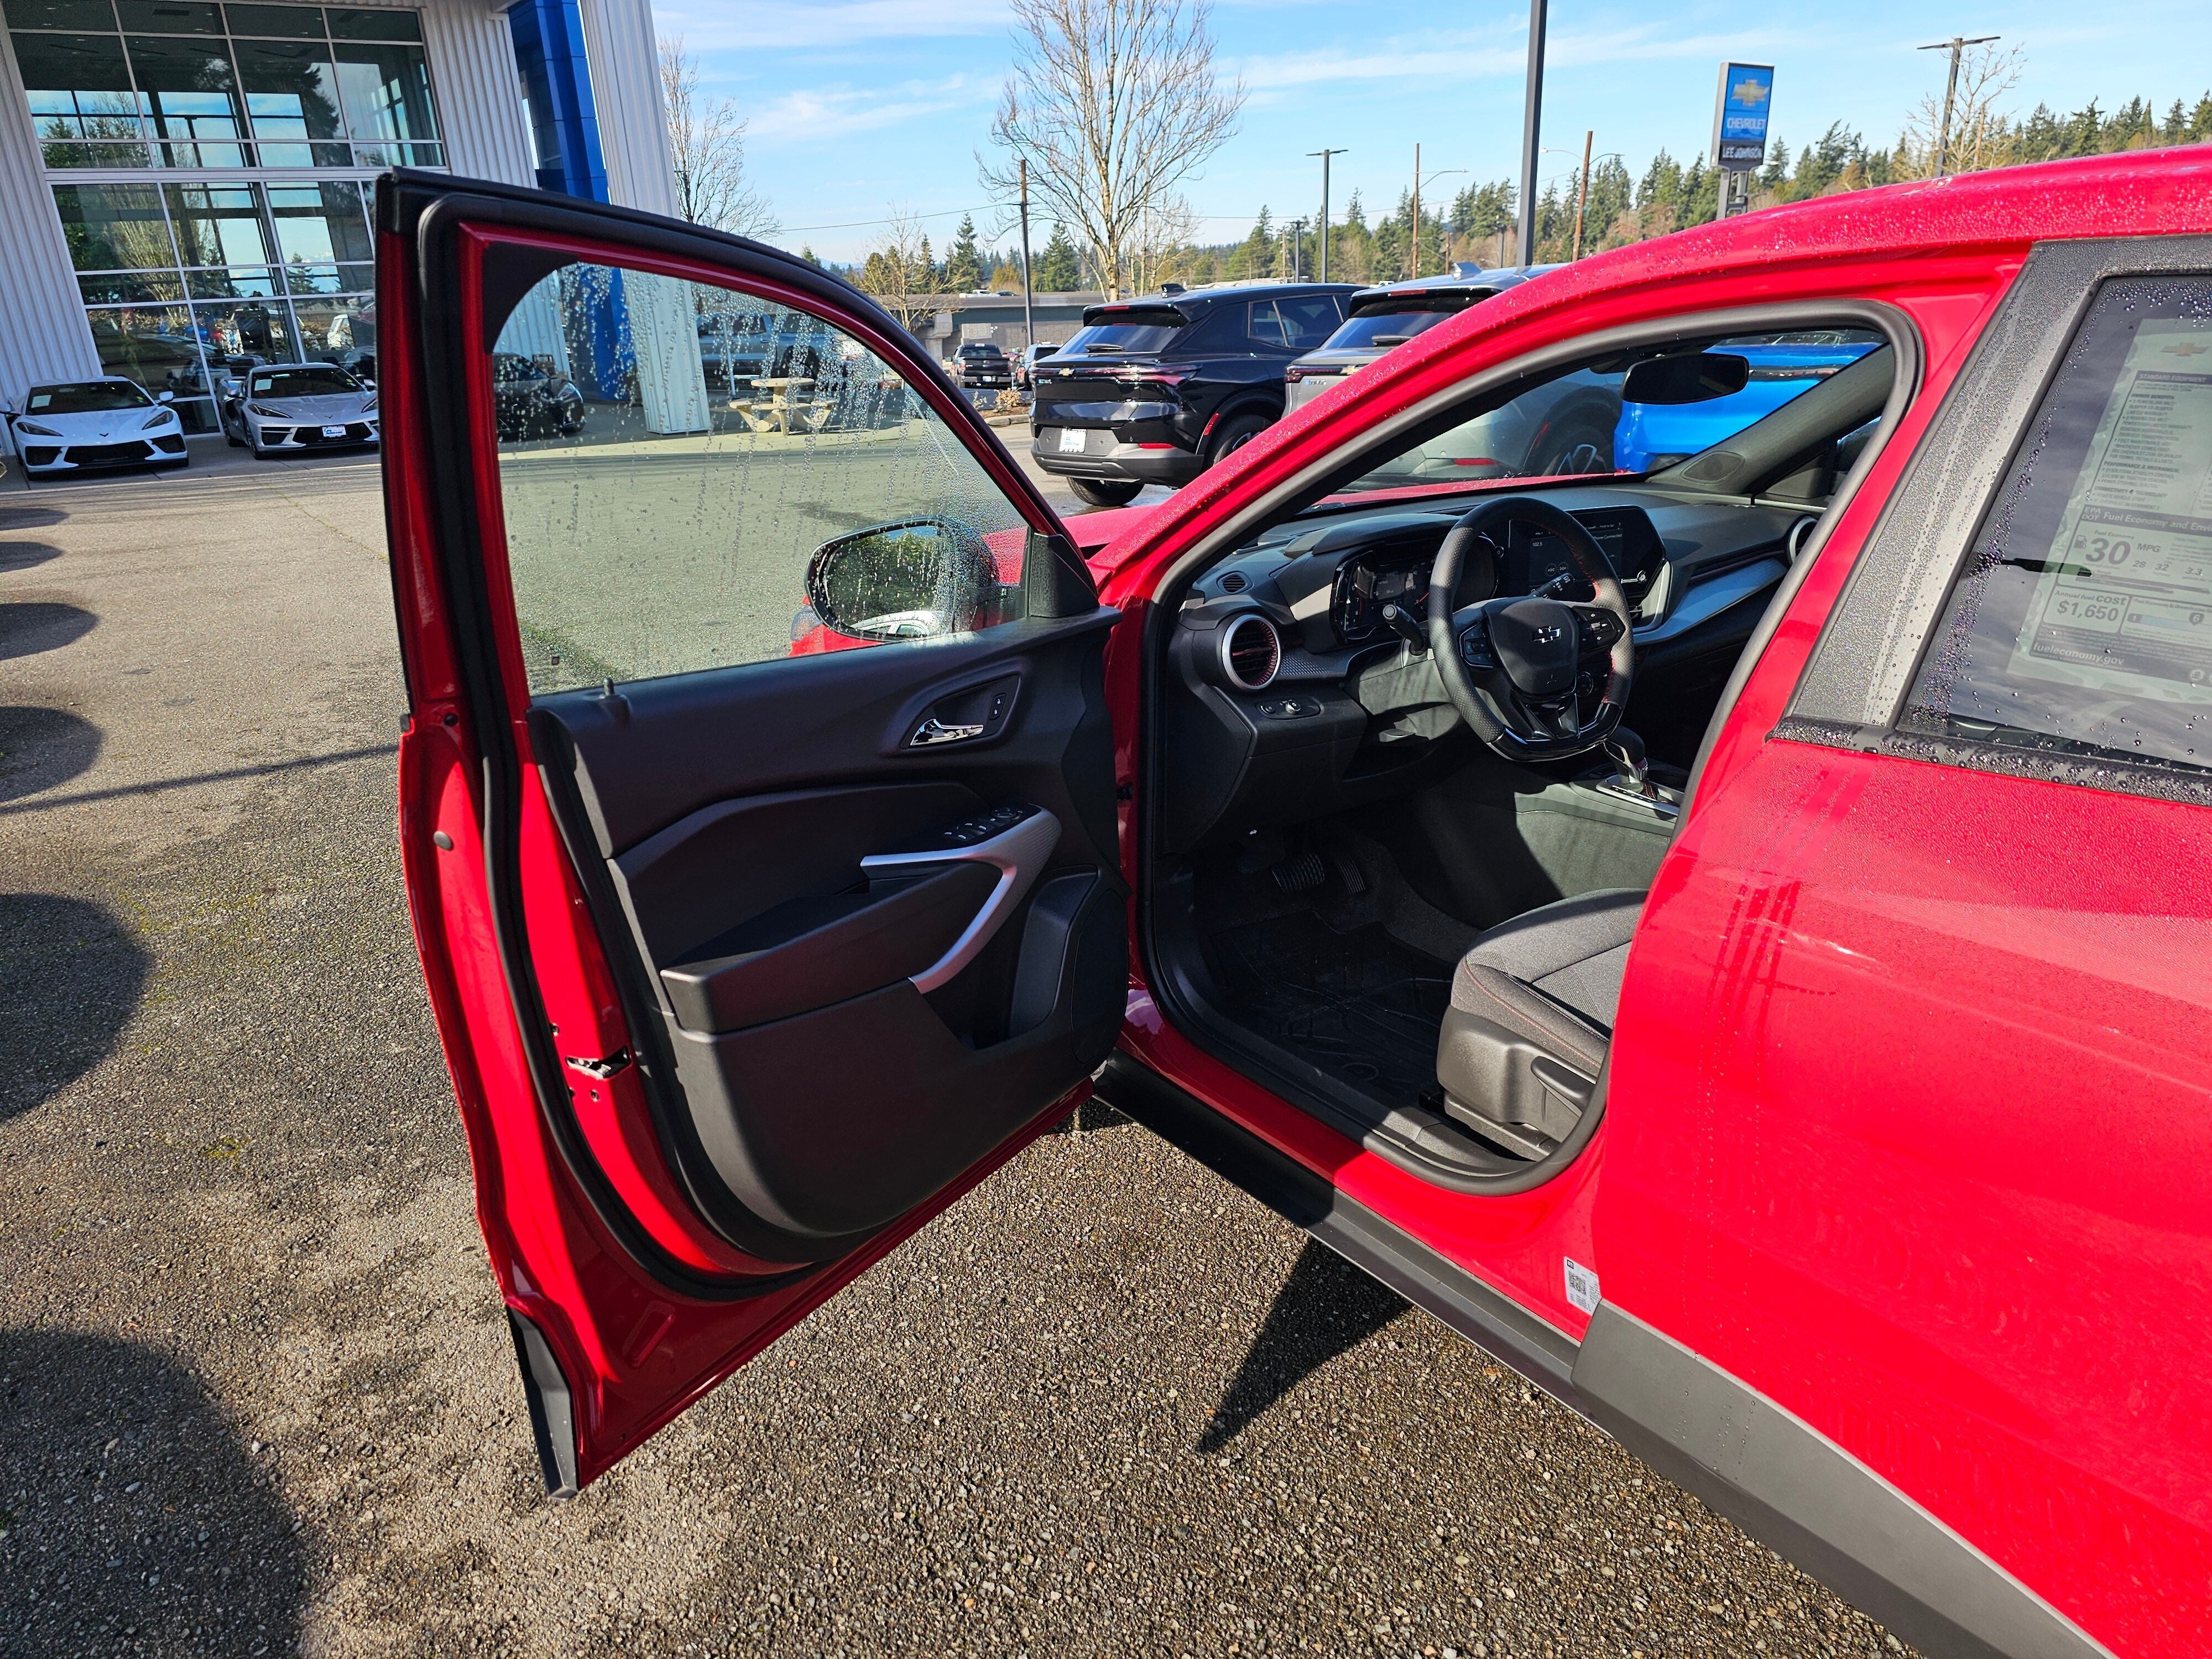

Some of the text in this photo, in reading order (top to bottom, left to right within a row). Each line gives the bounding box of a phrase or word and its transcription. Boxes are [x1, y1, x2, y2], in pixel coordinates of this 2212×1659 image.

[1727, 118, 1766, 129] CHEVROLET
[2103, 512, 2124, 521] Fuel
[2125, 515, 2168, 528] Economy
[2169, 521, 2189, 529] and
[2107, 531, 2135, 540] Economy
[2085, 538, 2131, 565] 30
[2137, 543, 2161, 552] MPG
[2132, 560, 2147, 568] 28
[2155, 563, 2169, 571] 32
[2185, 567, 2203, 576] 3.3
[2054, 590, 2080, 599] Annual
[2096, 594, 2128, 606] cost
[2057, 599, 2119, 622] $1,650
[2193, 614, 2200, 622] 6
[2032, 642, 2125, 665] fueleconomy.gov
